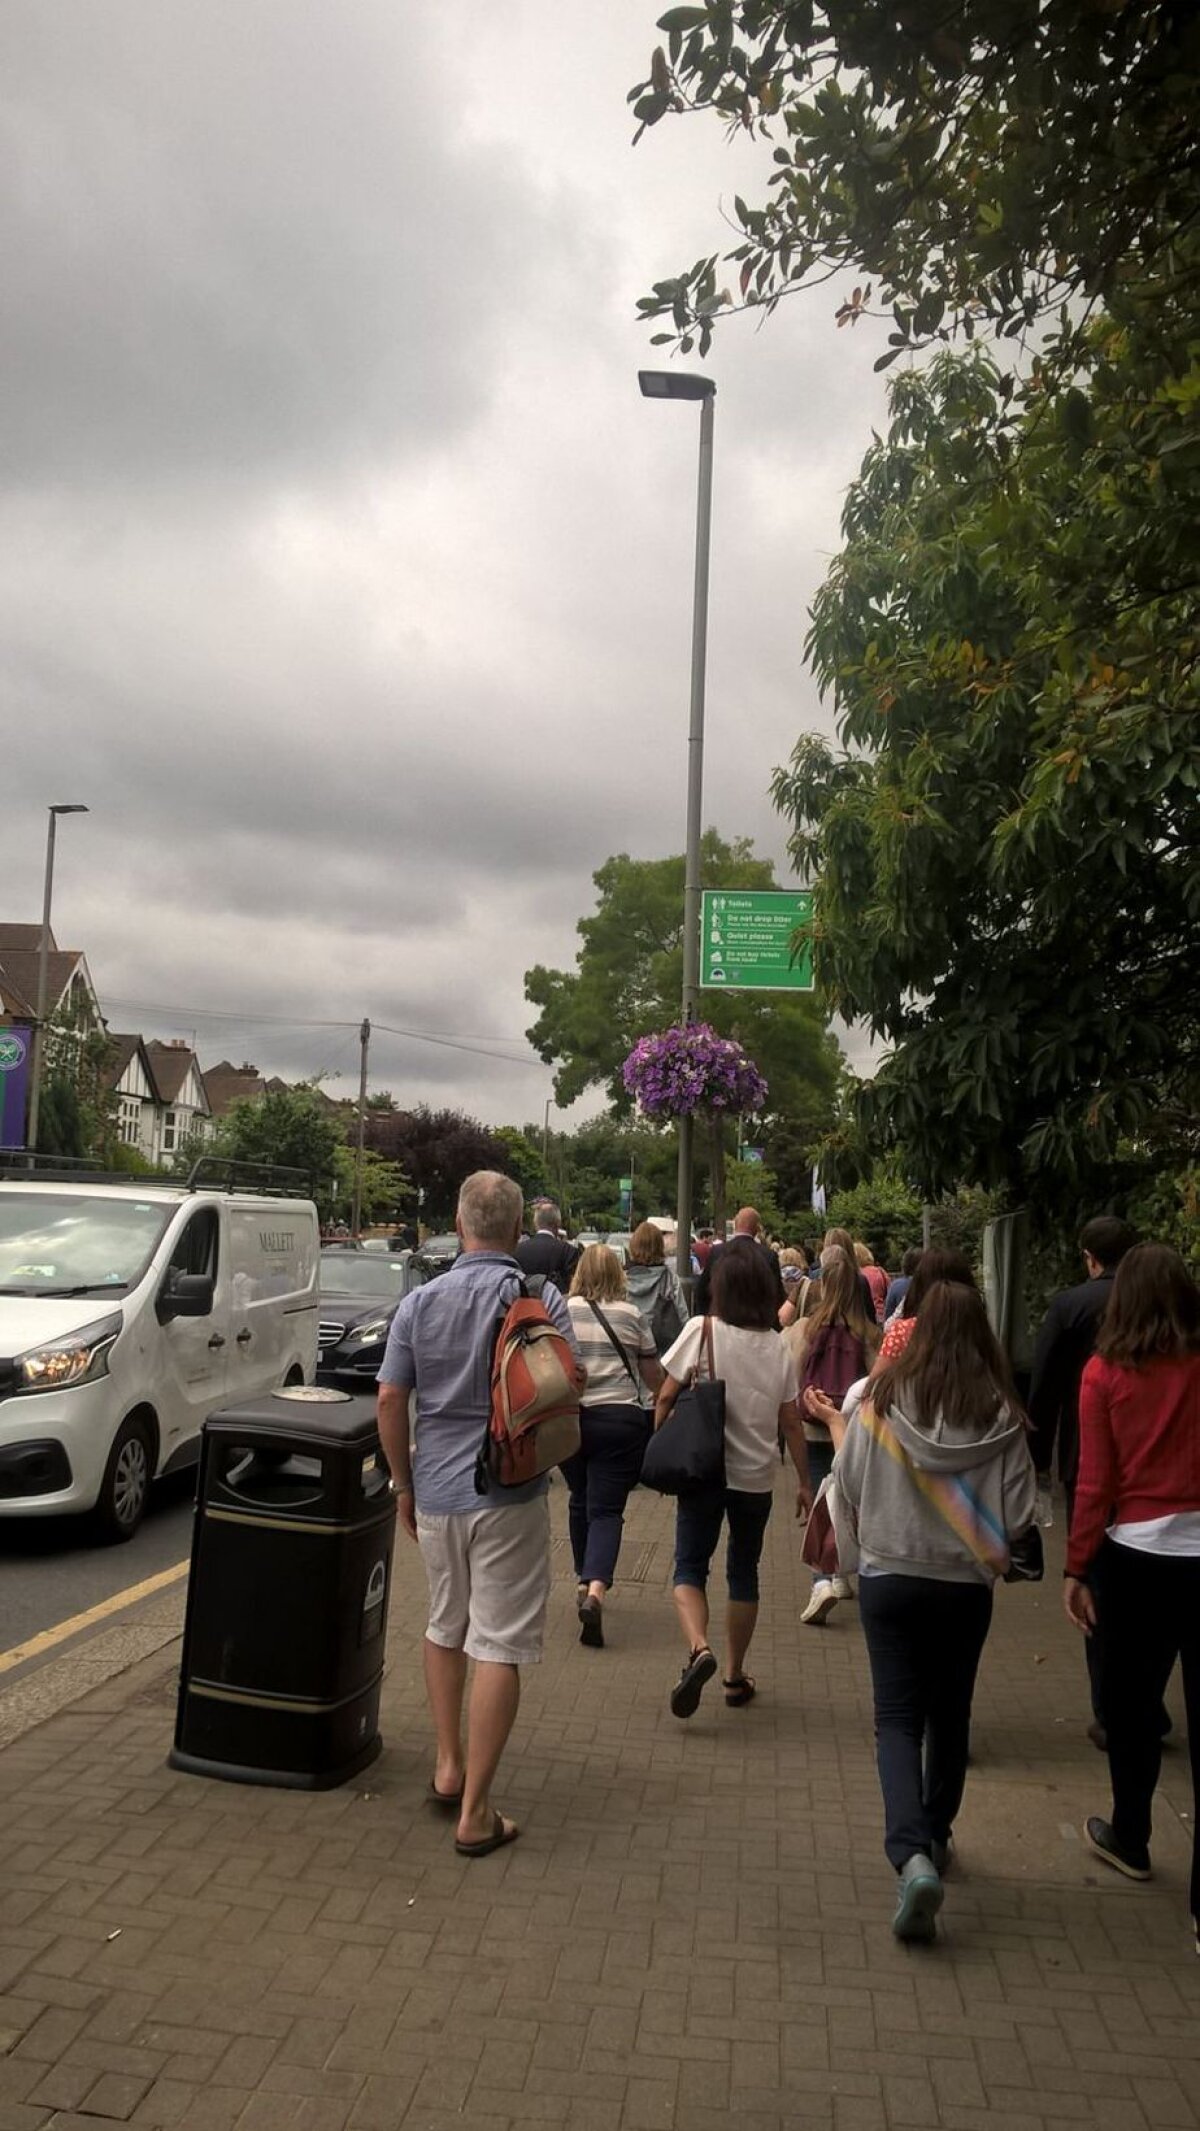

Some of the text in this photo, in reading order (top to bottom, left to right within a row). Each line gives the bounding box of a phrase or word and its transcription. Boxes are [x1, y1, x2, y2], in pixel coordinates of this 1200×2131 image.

[728, 900, 752, 908] Toilets
[727, 914, 738, 922] Do
[754, 915, 772, 923] drop
[773, 915, 792, 923] litter
[727, 932, 774, 941] Quiet please
[259, 1232, 295, 1252] MALLETT
